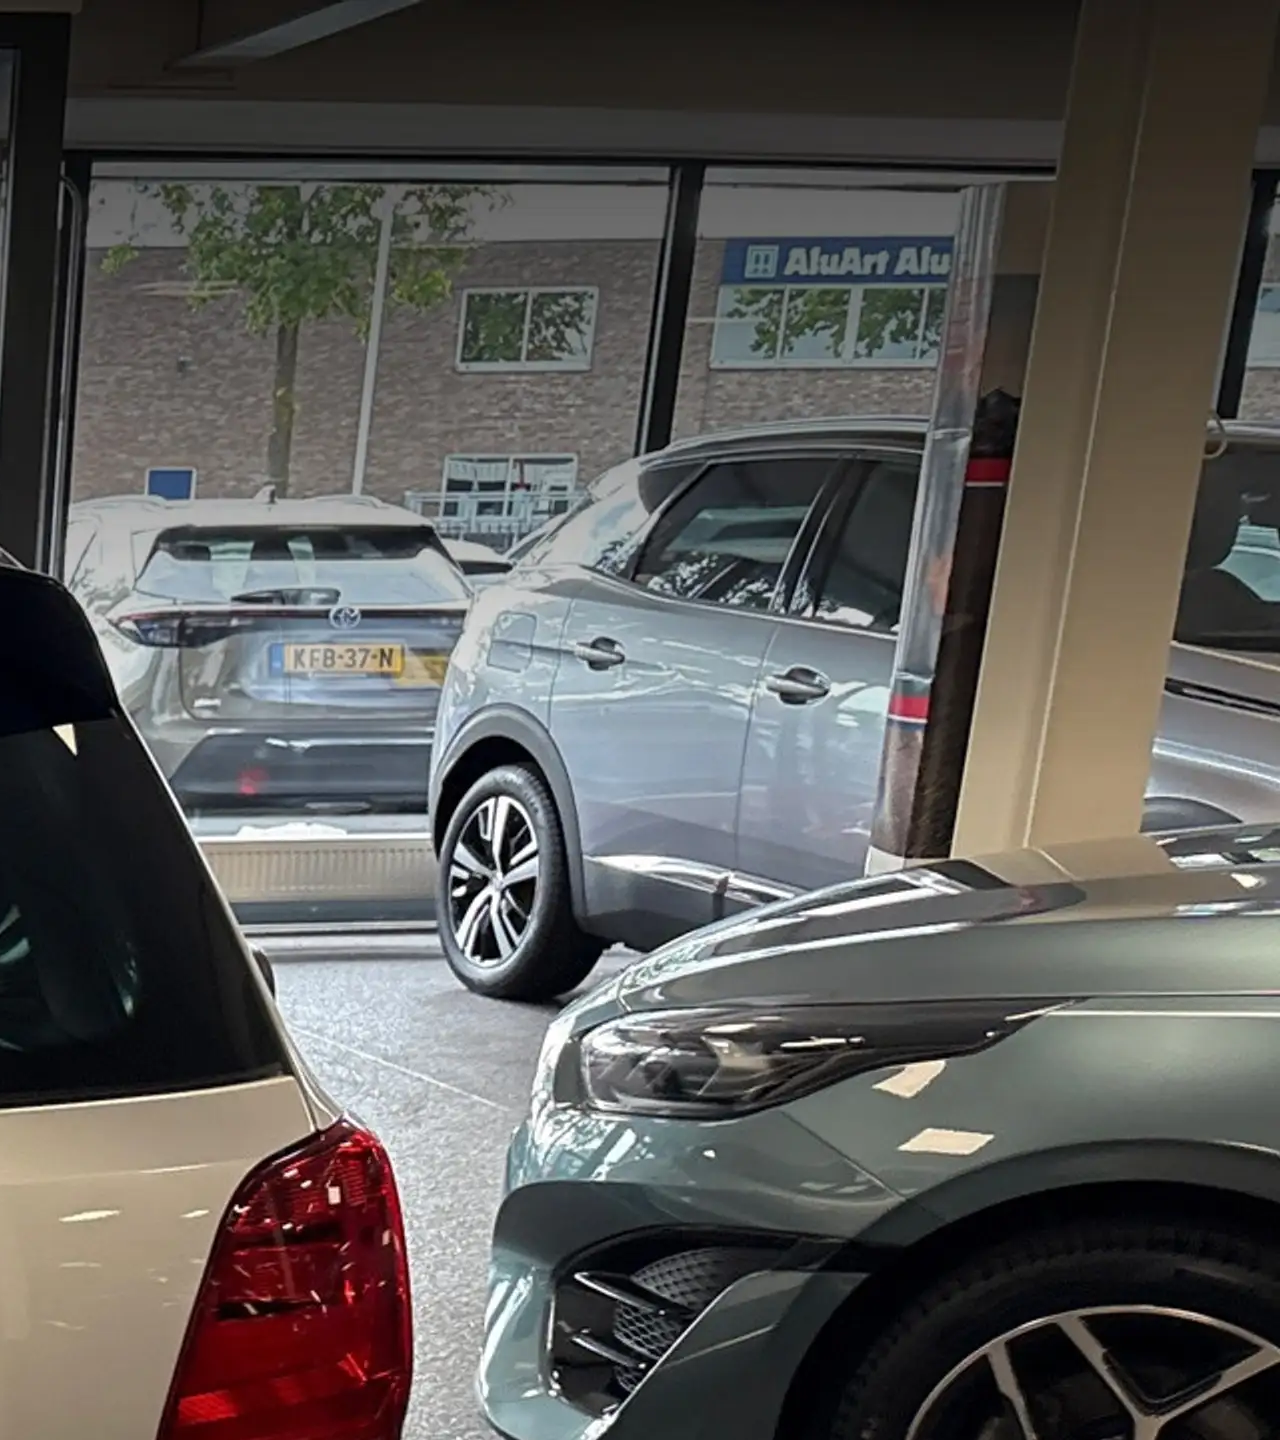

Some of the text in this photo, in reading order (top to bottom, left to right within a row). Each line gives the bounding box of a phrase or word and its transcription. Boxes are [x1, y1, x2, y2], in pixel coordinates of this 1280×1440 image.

[784, 246, 952, 276] AluArt Alu
[294, 647, 395, 670] KFB-37-N
